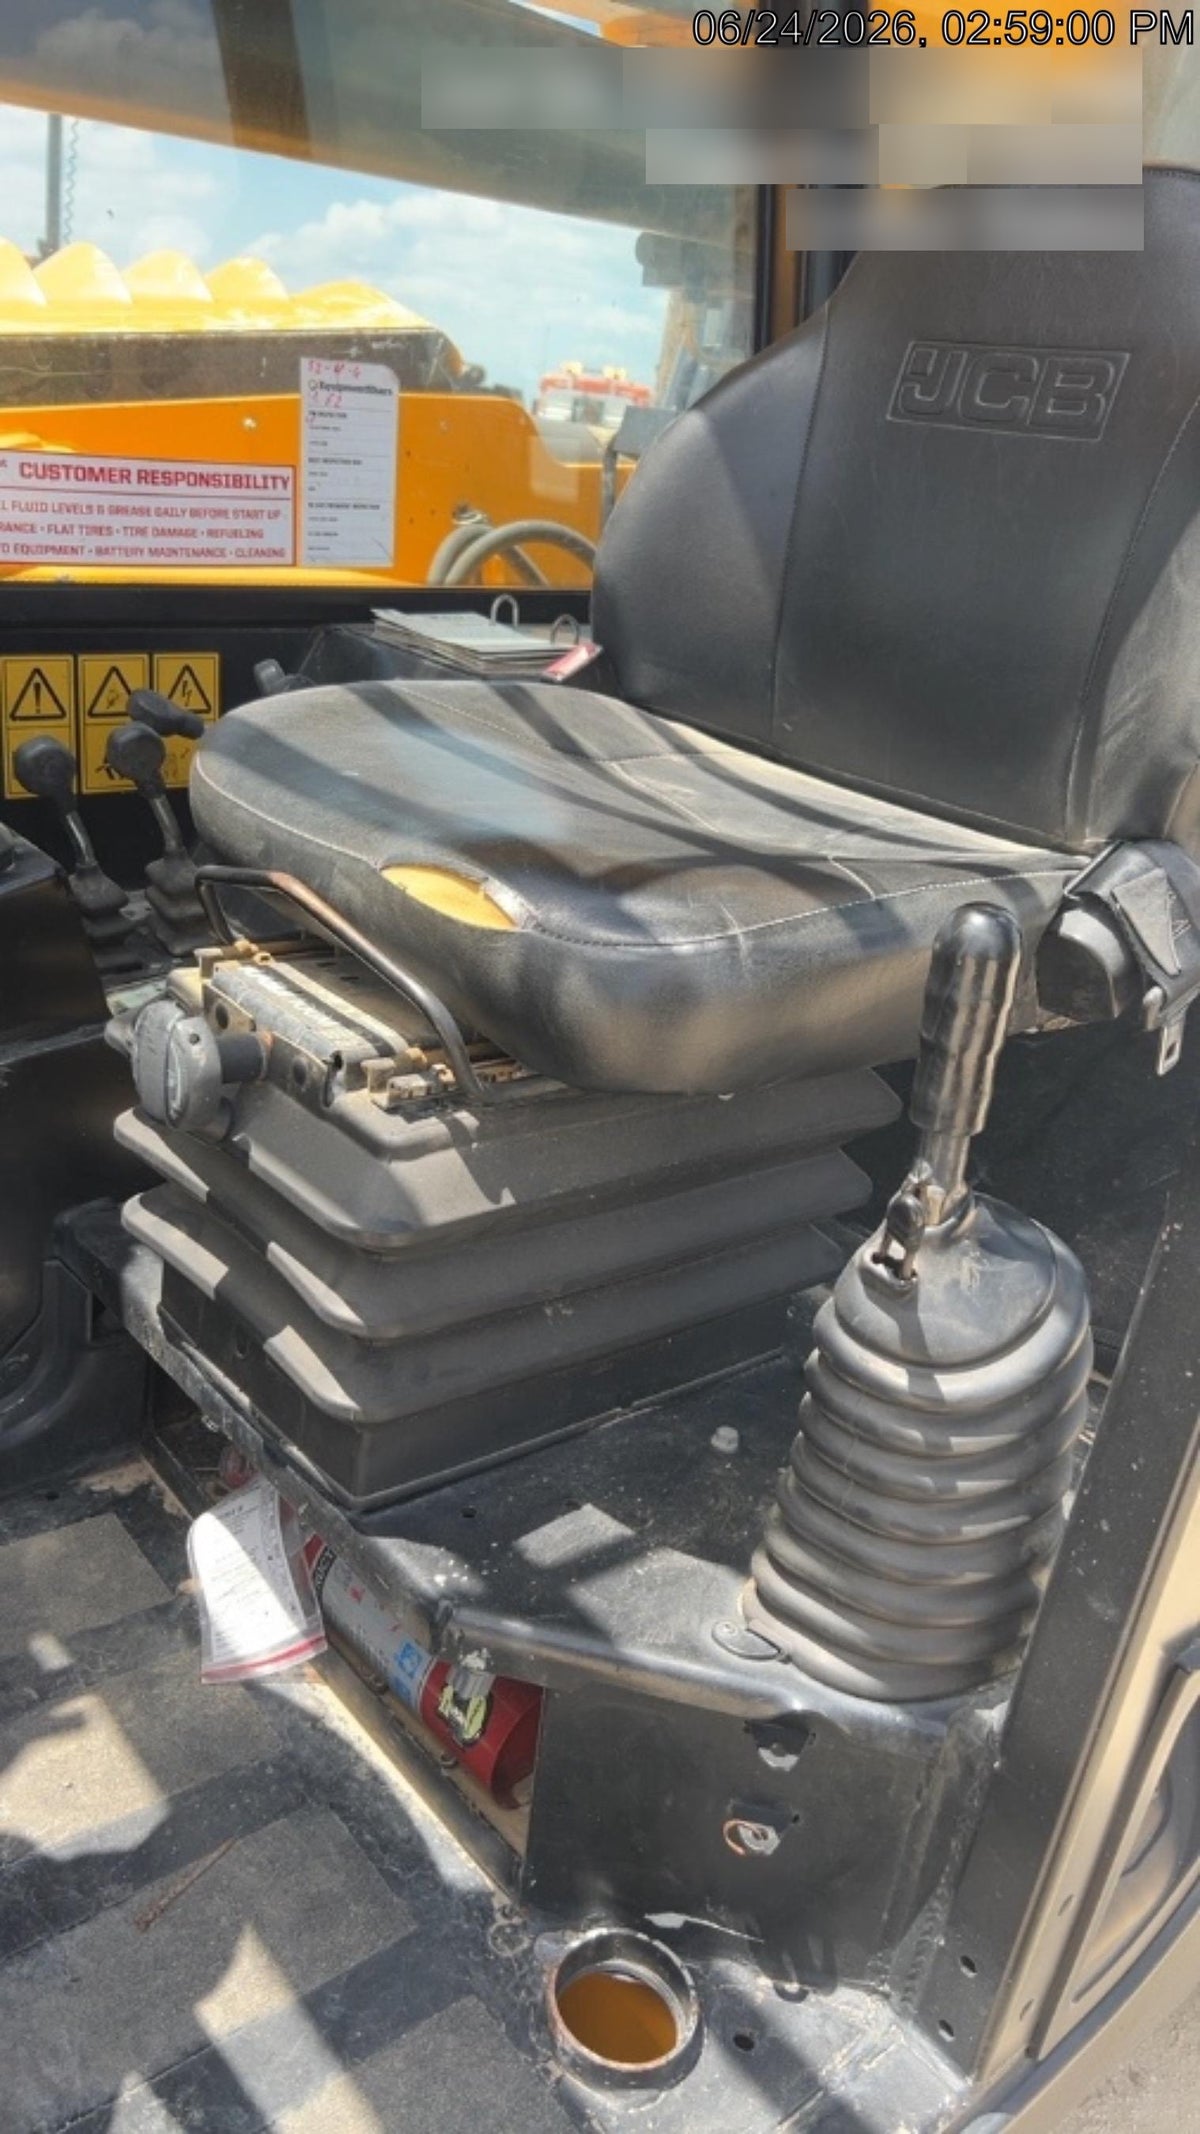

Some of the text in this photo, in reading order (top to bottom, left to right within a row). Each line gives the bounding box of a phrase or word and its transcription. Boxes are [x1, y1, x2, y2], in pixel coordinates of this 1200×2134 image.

[898, 347, 1115, 430] JCB
[19, 461, 132, 484] CUSTOMER
[136, 468, 291, 491] RESPONSIBILITY
[11, 500, 49, 514] FLUID
[51, 501, 94, 516] LEVELS
[107, 504, 152, 518] GREASE
[188, 507, 230, 520] BEFORE
[232, 508, 265, 520] START
[46, 523, 76, 536] FLAT
[78, 524, 115, 537] TIRES
[123, 525, 149, 538] TIRE
[151, 526, 198, 539] DAMAGE
[206, 527, 265, 539] REFUELING
[13, 542, 85, 556] EQUIPMENT
[94, 544, 146, 558] BATTERY
[148, 546, 228, 559] MAINTENANCE
[234, 546, 287, 559] CLEANING
